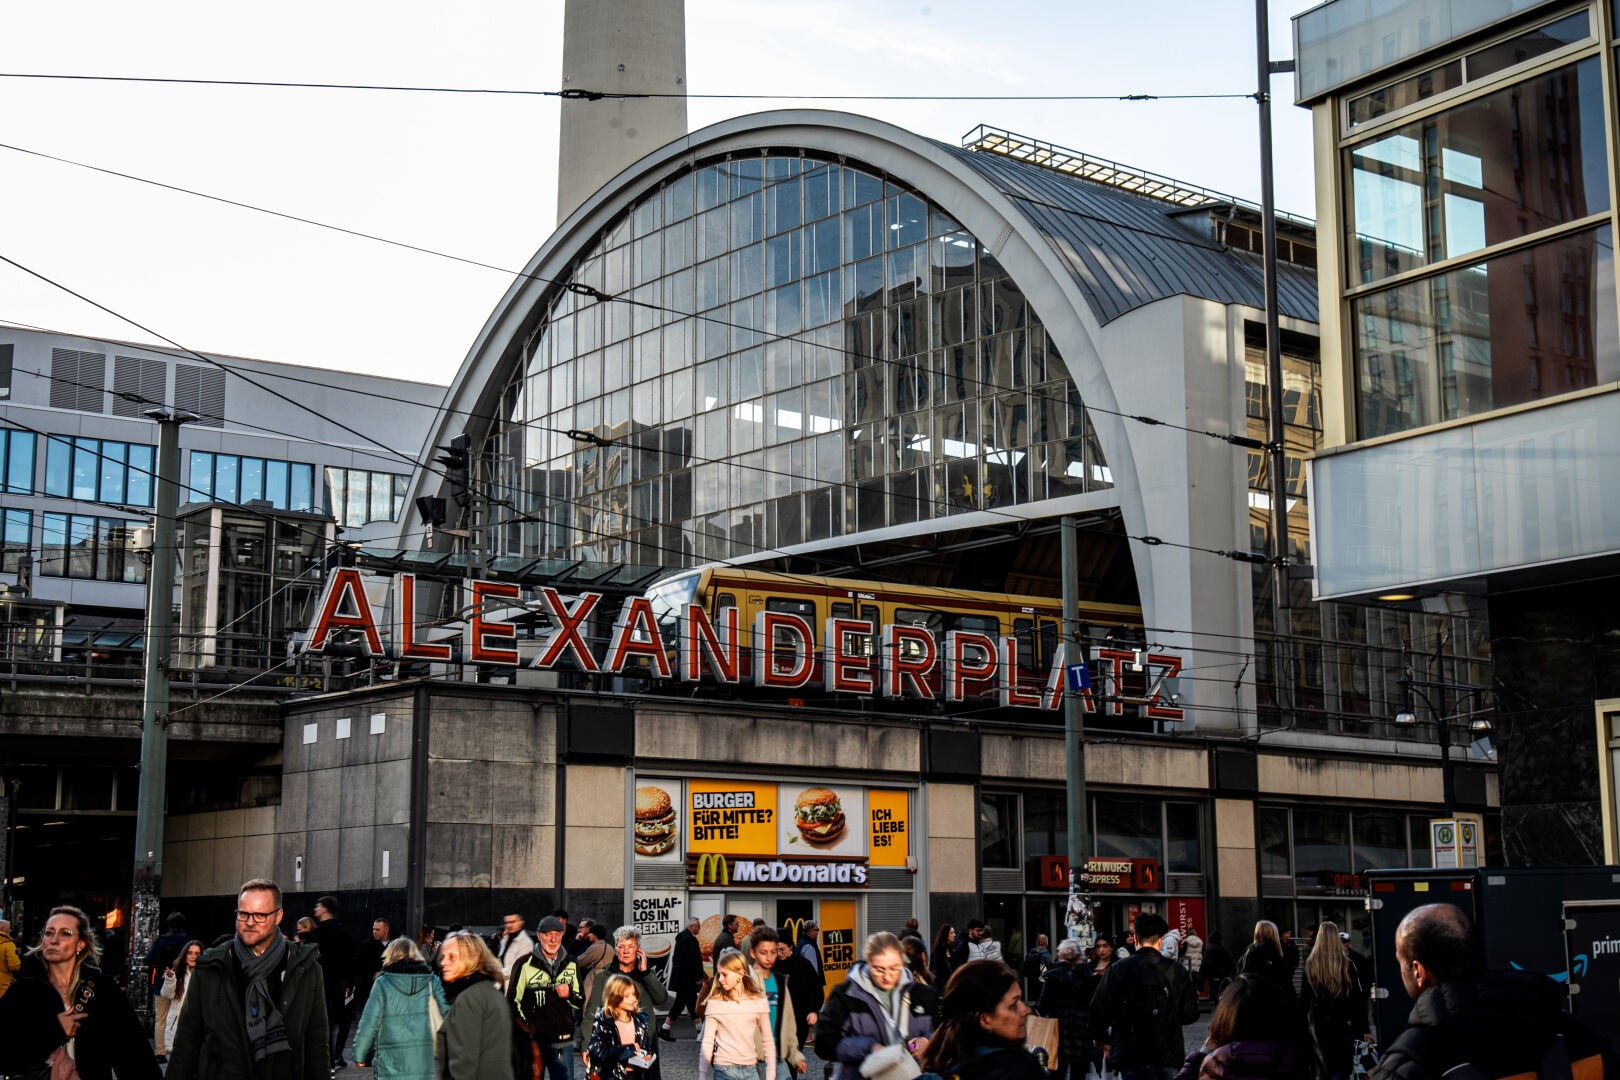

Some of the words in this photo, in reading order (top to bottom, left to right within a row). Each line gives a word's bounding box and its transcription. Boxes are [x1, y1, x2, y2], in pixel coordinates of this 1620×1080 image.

[1071, 665, 1084, 687] T
[693, 792, 754, 809] BURGER
[723, 809, 773, 824] MITTE?
[872, 809, 892, 821] ICH
[693, 825, 739, 841] BITTE!
[872, 821, 905, 833] LIEBE
[873, 835, 892, 847] ES!
[733, 861, 868, 884] McDonald's
[633, 897, 682, 911] SCHLAF-
[633, 910, 655, 922] LOS
[657, 909, 669, 921] IN
[823, 962, 841, 972] DICH
